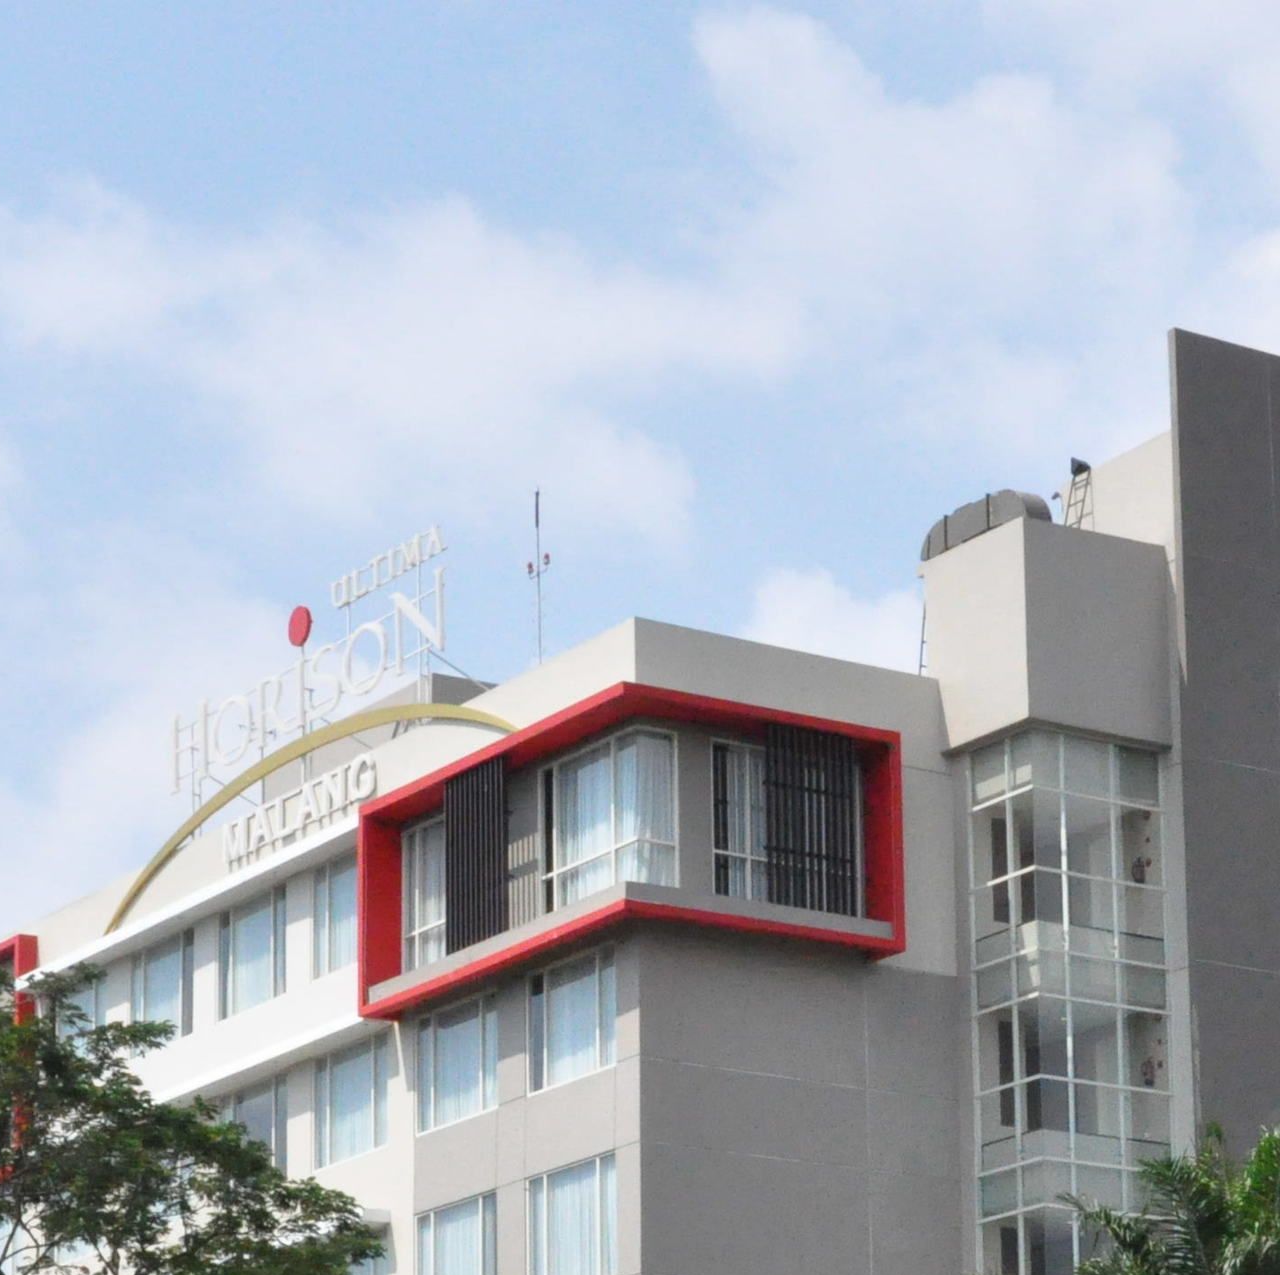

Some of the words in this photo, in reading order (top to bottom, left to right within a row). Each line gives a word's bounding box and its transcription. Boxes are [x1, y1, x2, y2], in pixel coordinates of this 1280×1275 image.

[330, 523, 449, 609] ULTIMA
[170, 567, 446, 796] HORISON
[223, 753, 378, 863] MALANG
